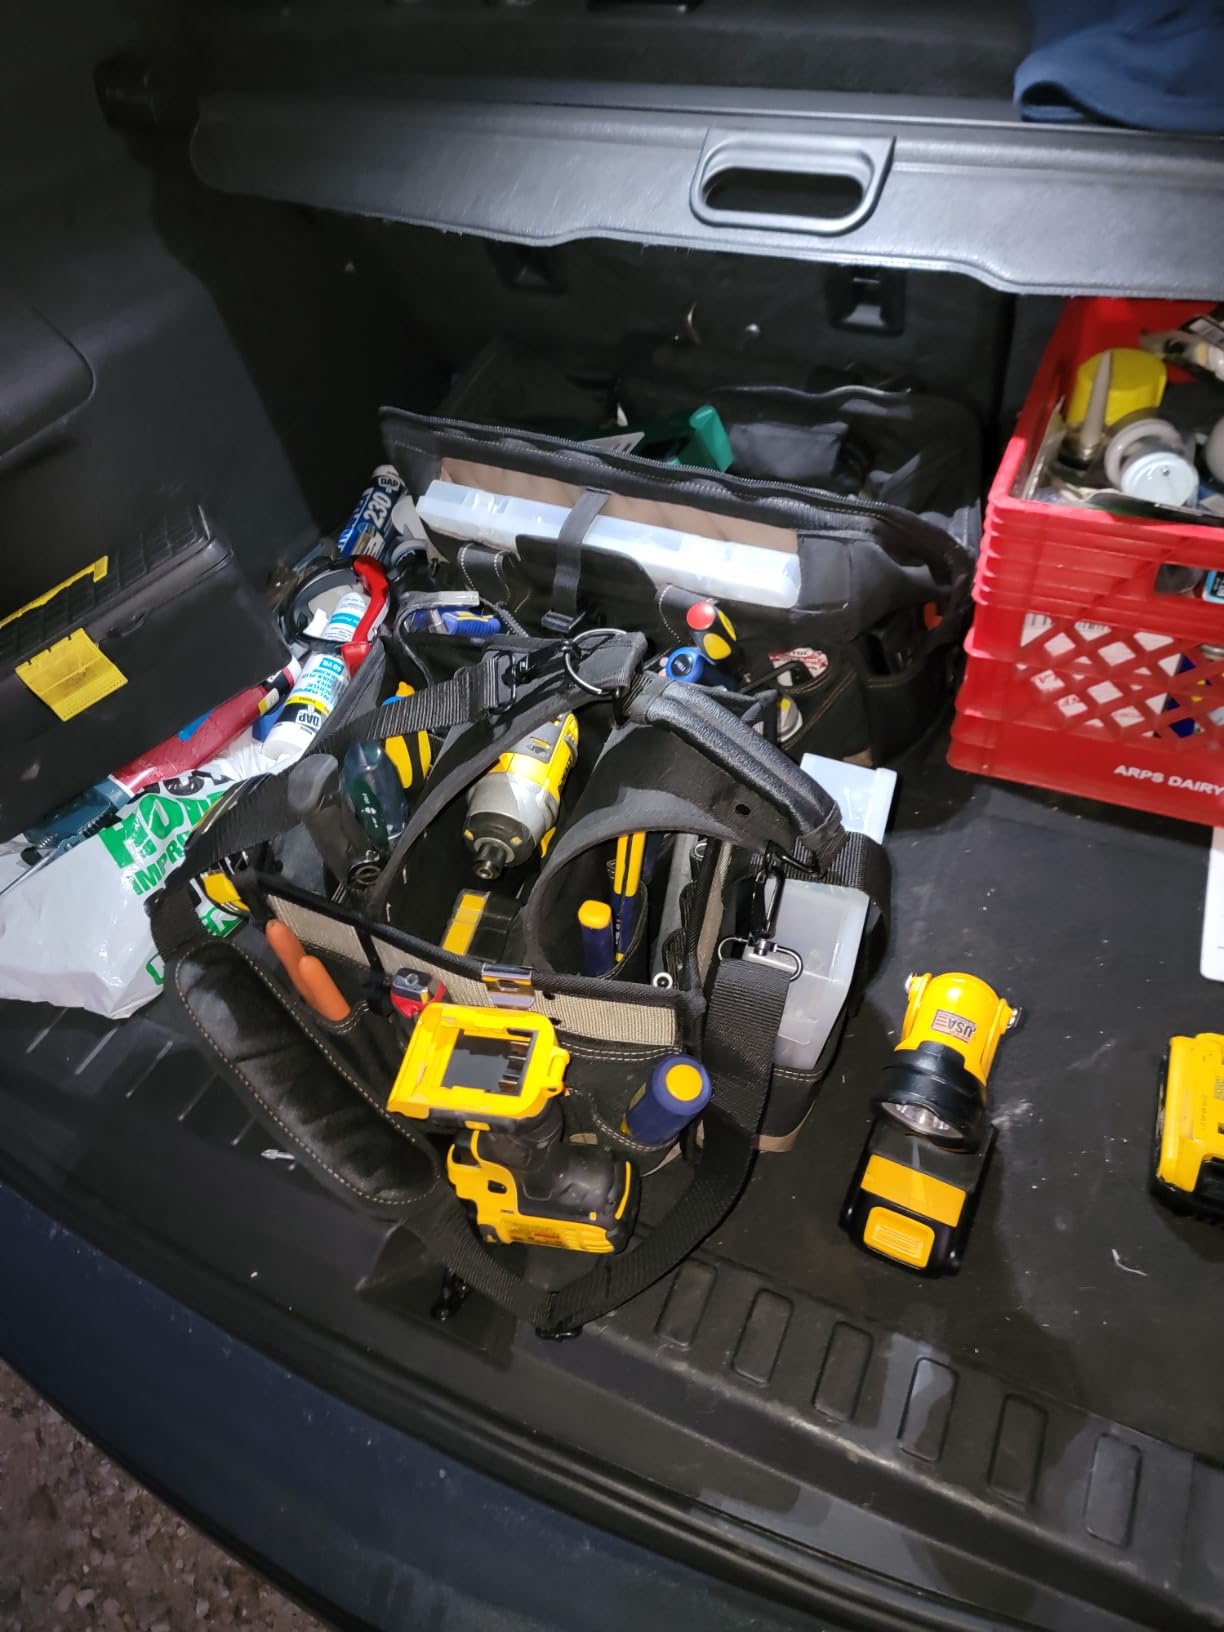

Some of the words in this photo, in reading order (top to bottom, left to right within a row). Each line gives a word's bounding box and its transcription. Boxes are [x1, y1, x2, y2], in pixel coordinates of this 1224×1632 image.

[380, 477, 399, 488] DAP
[363, 491, 392, 529] 230
[298, 711, 321, 726] DAP
[1113, 764, 1164, 783] ARPS
[1167, 775, 1224, 796] DAIRY
[948, 1017, 973, 1038] USA
